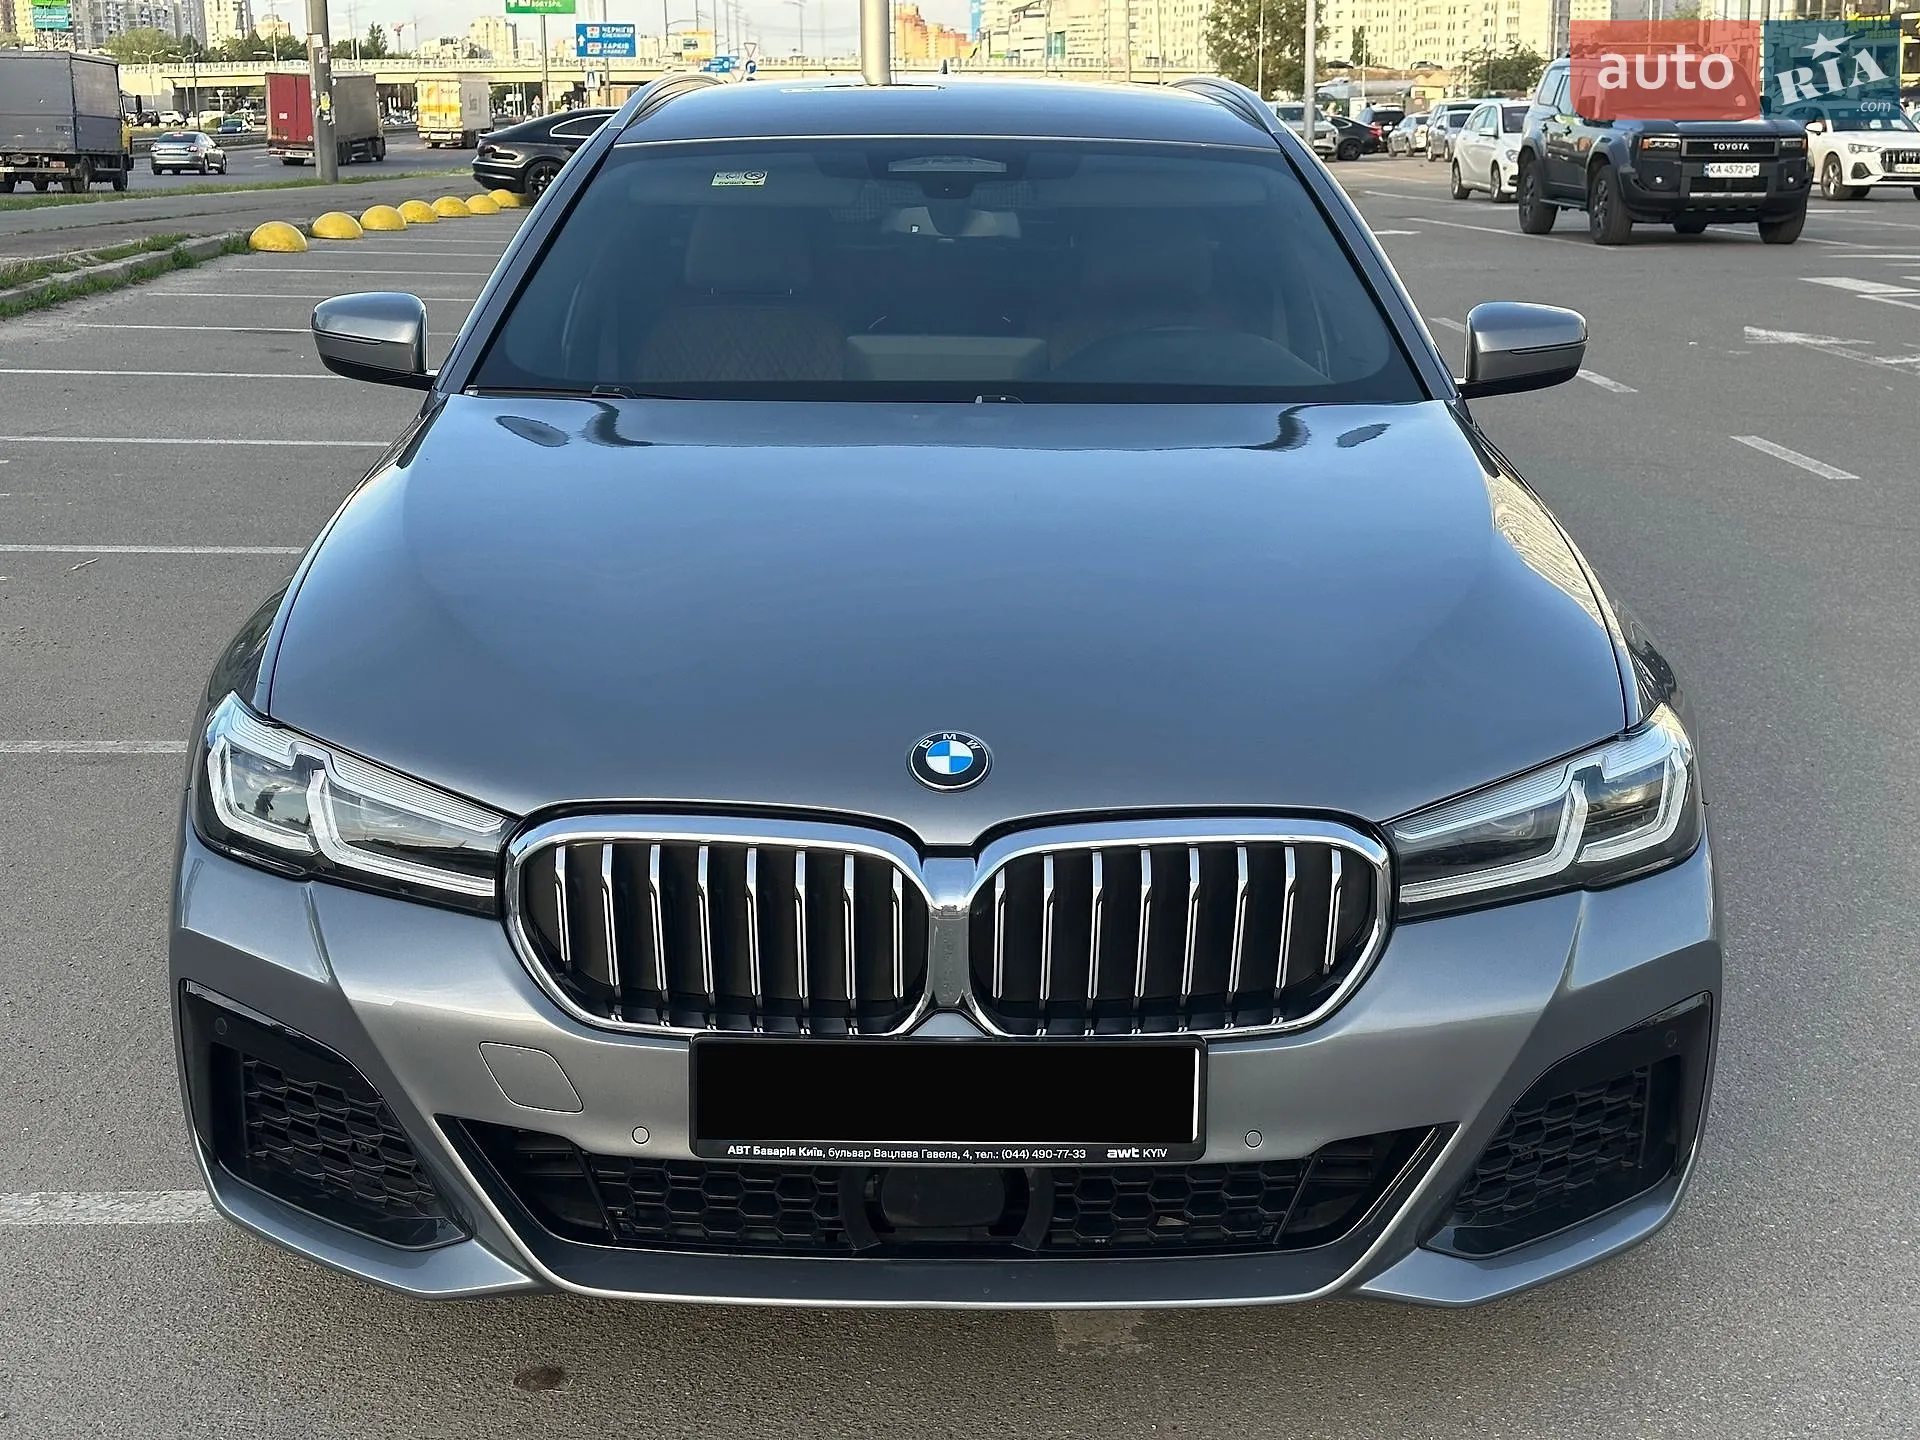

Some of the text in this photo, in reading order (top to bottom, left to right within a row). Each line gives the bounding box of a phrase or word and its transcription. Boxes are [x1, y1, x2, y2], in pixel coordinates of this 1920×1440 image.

[1712, 143, 1750, 151] TOYOTA
[1723, 164, 1744, 174] 4572
[919, 733, 981, 750] BMW
[727, 1145, 751, 1155] АВТ
[752, 1146, 797, 1157] Баварія
[828, 1148, 871, 1159] бульвар
[873, 1149, 919, 1160] Вацлава
[921, 1149, 961, 1161] Гавела,
[962, 1149, 973, 1160] 4,
[974, 1150, 999, 1160] тел.:
[1001, 1149, 1030, 1160] (044)
[1031, 1149, 1086, 1159] 490-77-33
[1106, 1148, 1168, 1159] awt KYIV
